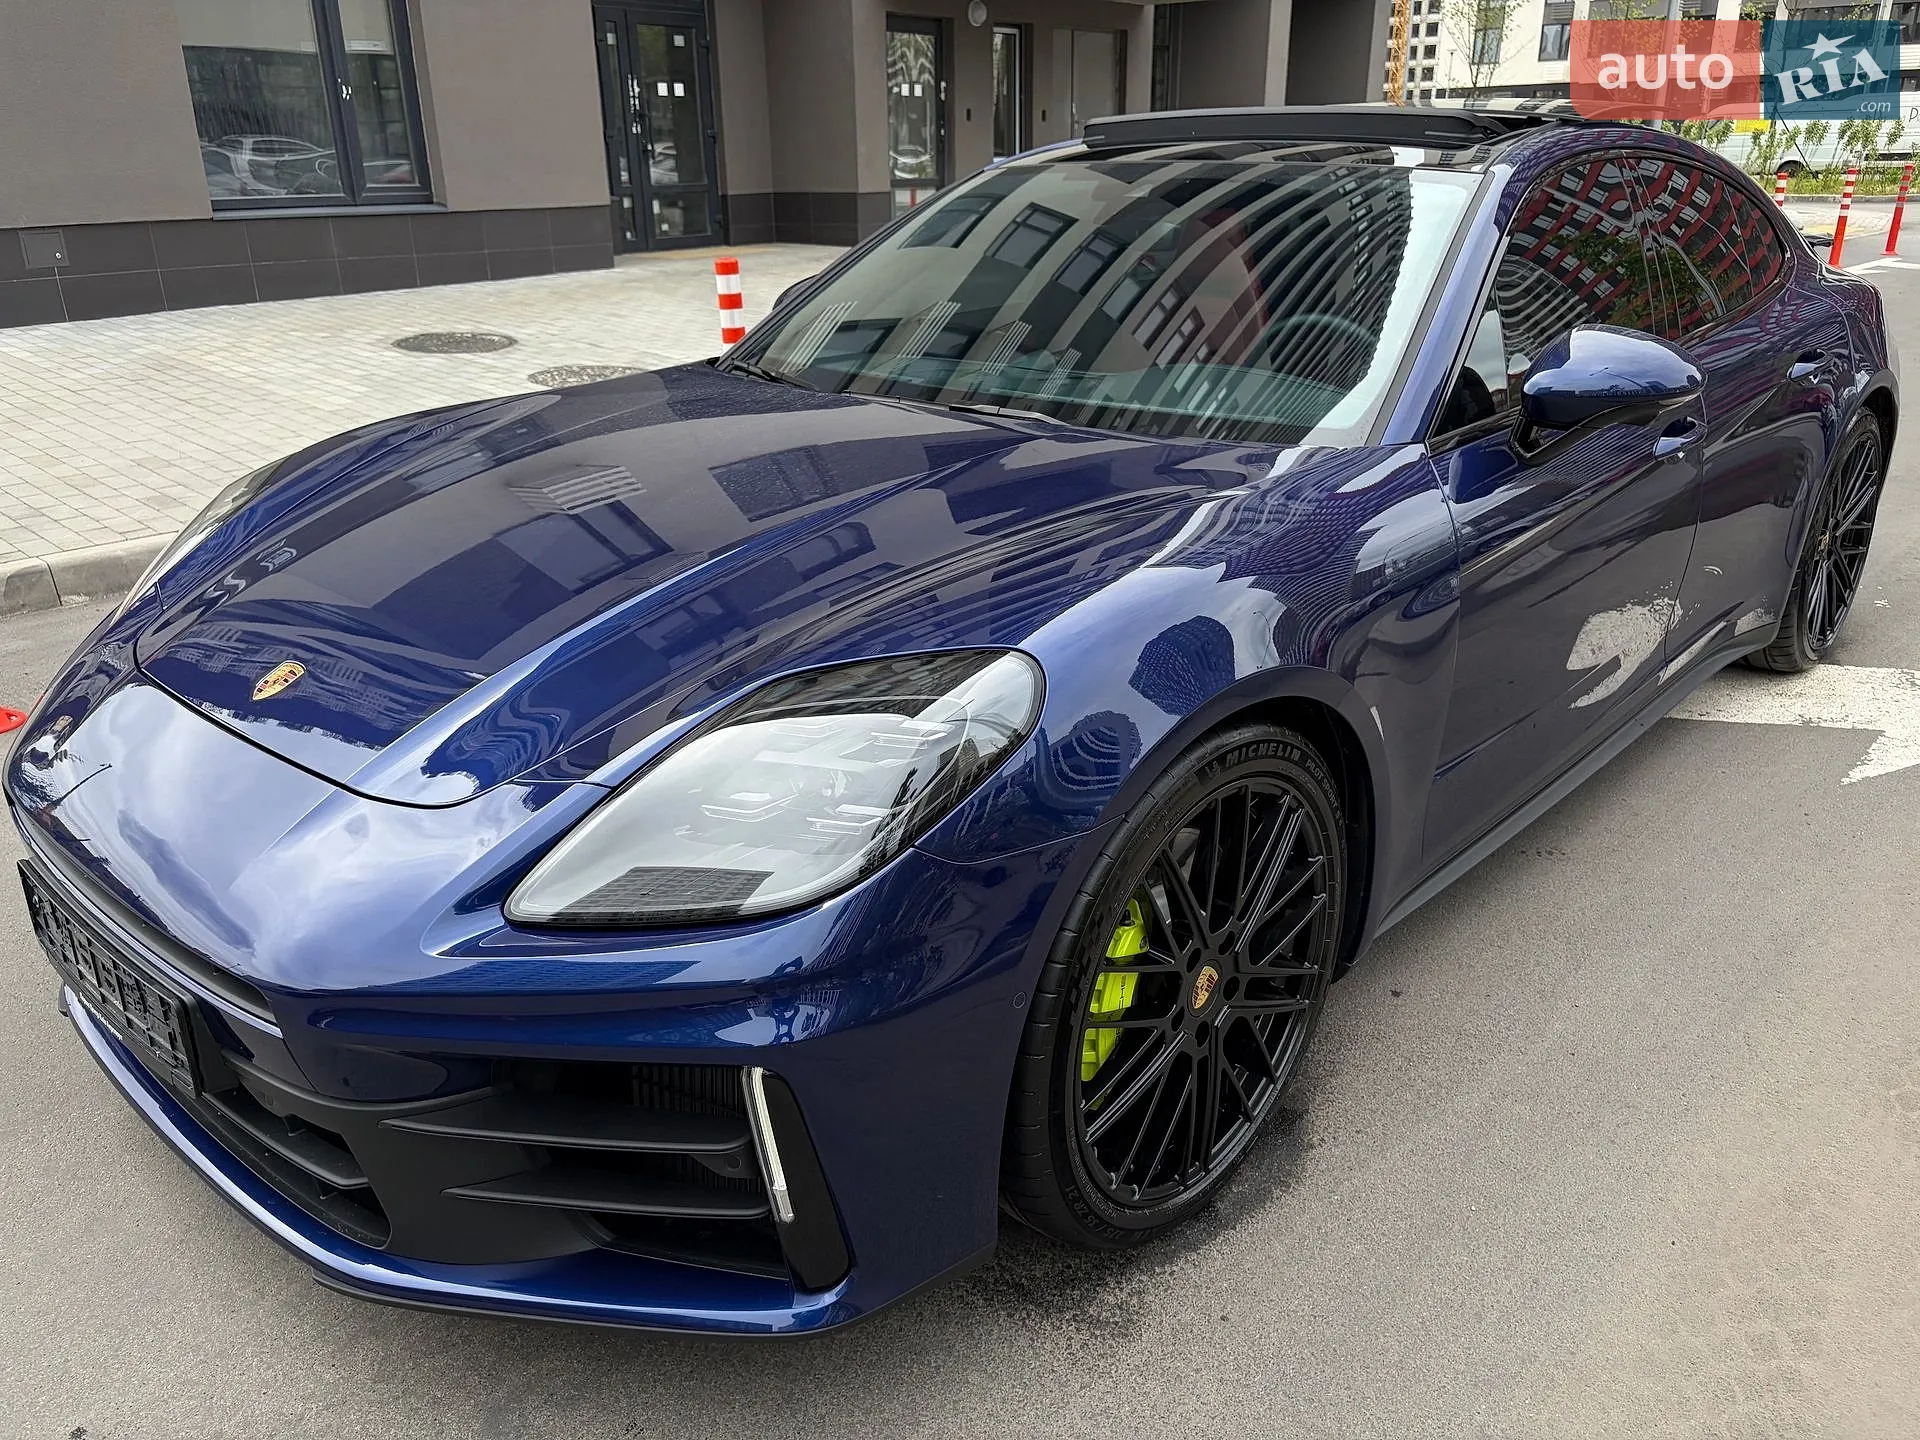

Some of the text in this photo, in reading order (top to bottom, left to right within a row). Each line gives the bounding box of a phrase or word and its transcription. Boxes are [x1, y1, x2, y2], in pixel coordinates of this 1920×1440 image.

[1226, 742, 1301, 768] MICHELIN
[1305, 758, 1324, 780] PILOT
[1322, 779, 1338, 808] SPORT
